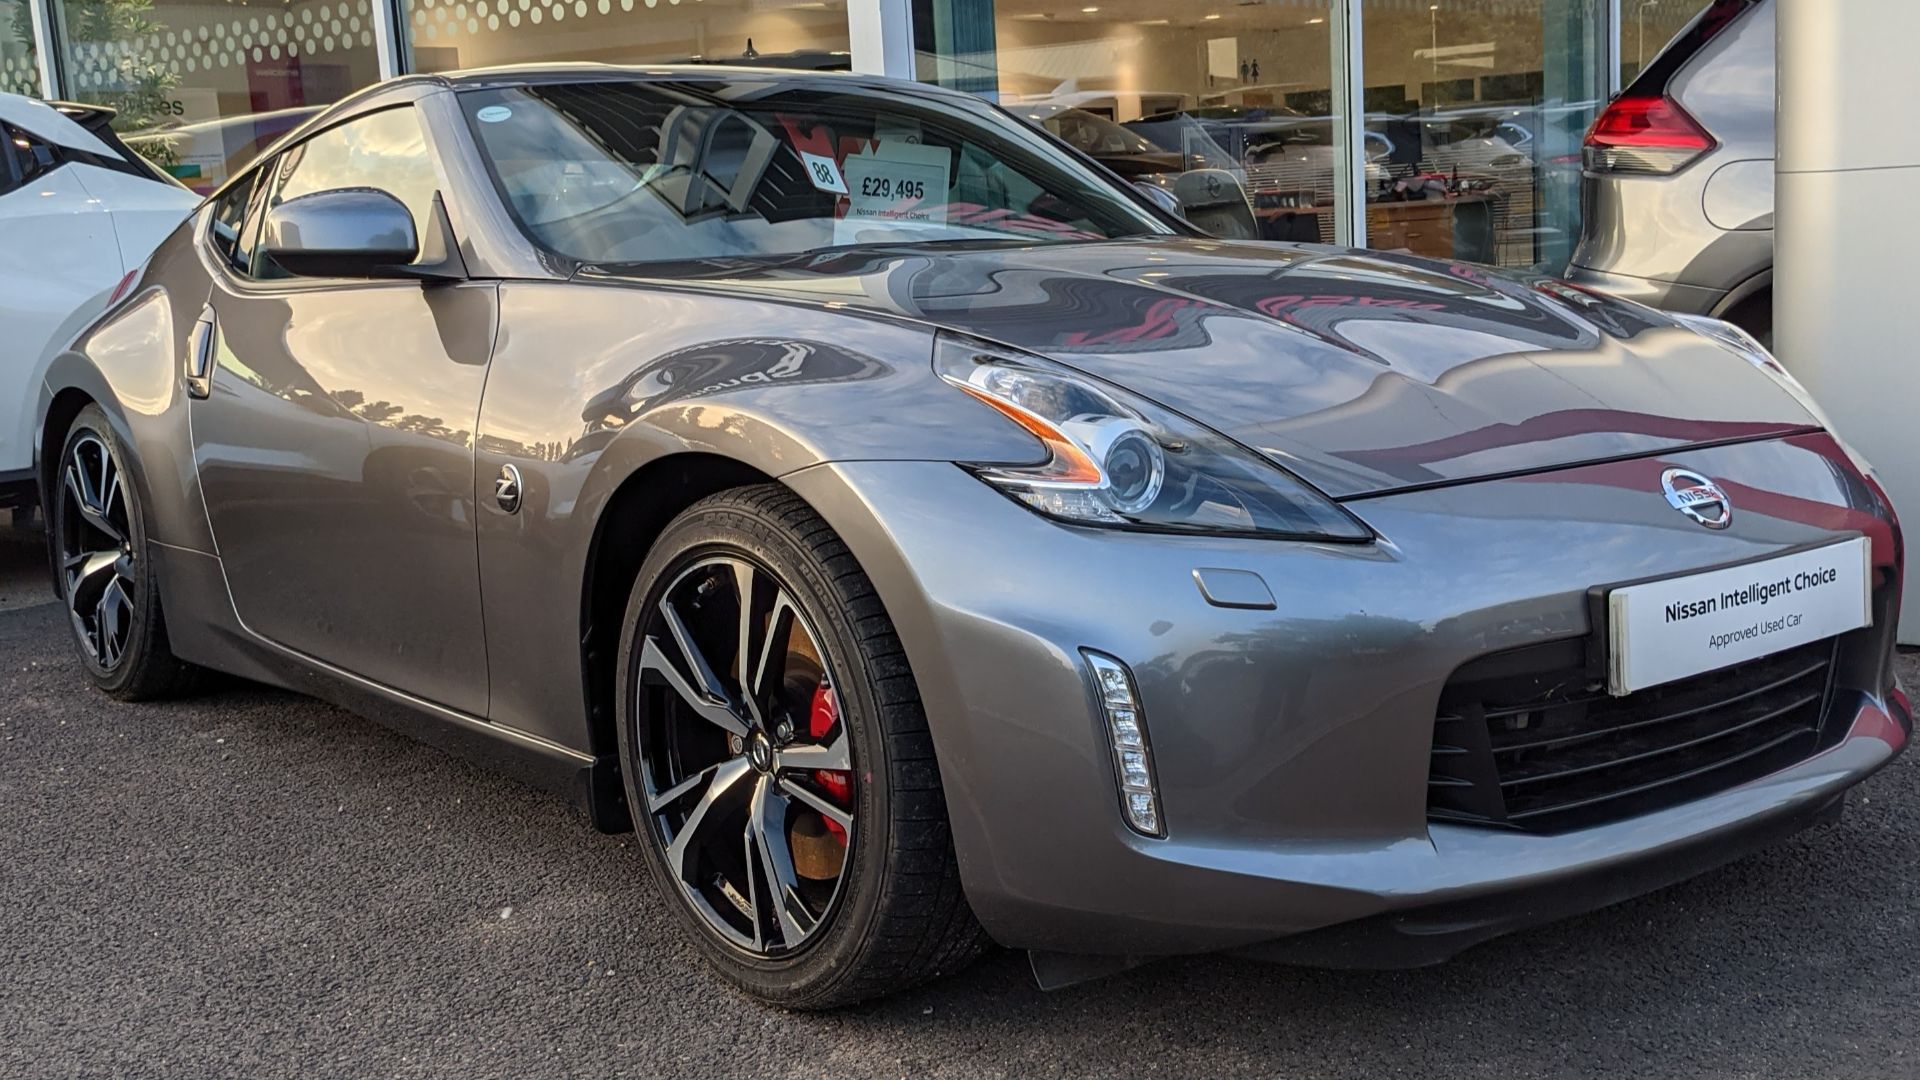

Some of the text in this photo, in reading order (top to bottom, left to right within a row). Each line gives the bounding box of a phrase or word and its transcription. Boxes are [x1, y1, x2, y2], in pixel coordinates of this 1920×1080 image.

[812, 161, 834, 185] 88
[862, 177, 924, 201] £29,495
[857, 208, 930, 220] Nissan Intelligent Choice
[1665, 567, 1836, 623] Nissan Intelligent Choice
[1709, 613, 1803, 650] Approved Used Car
